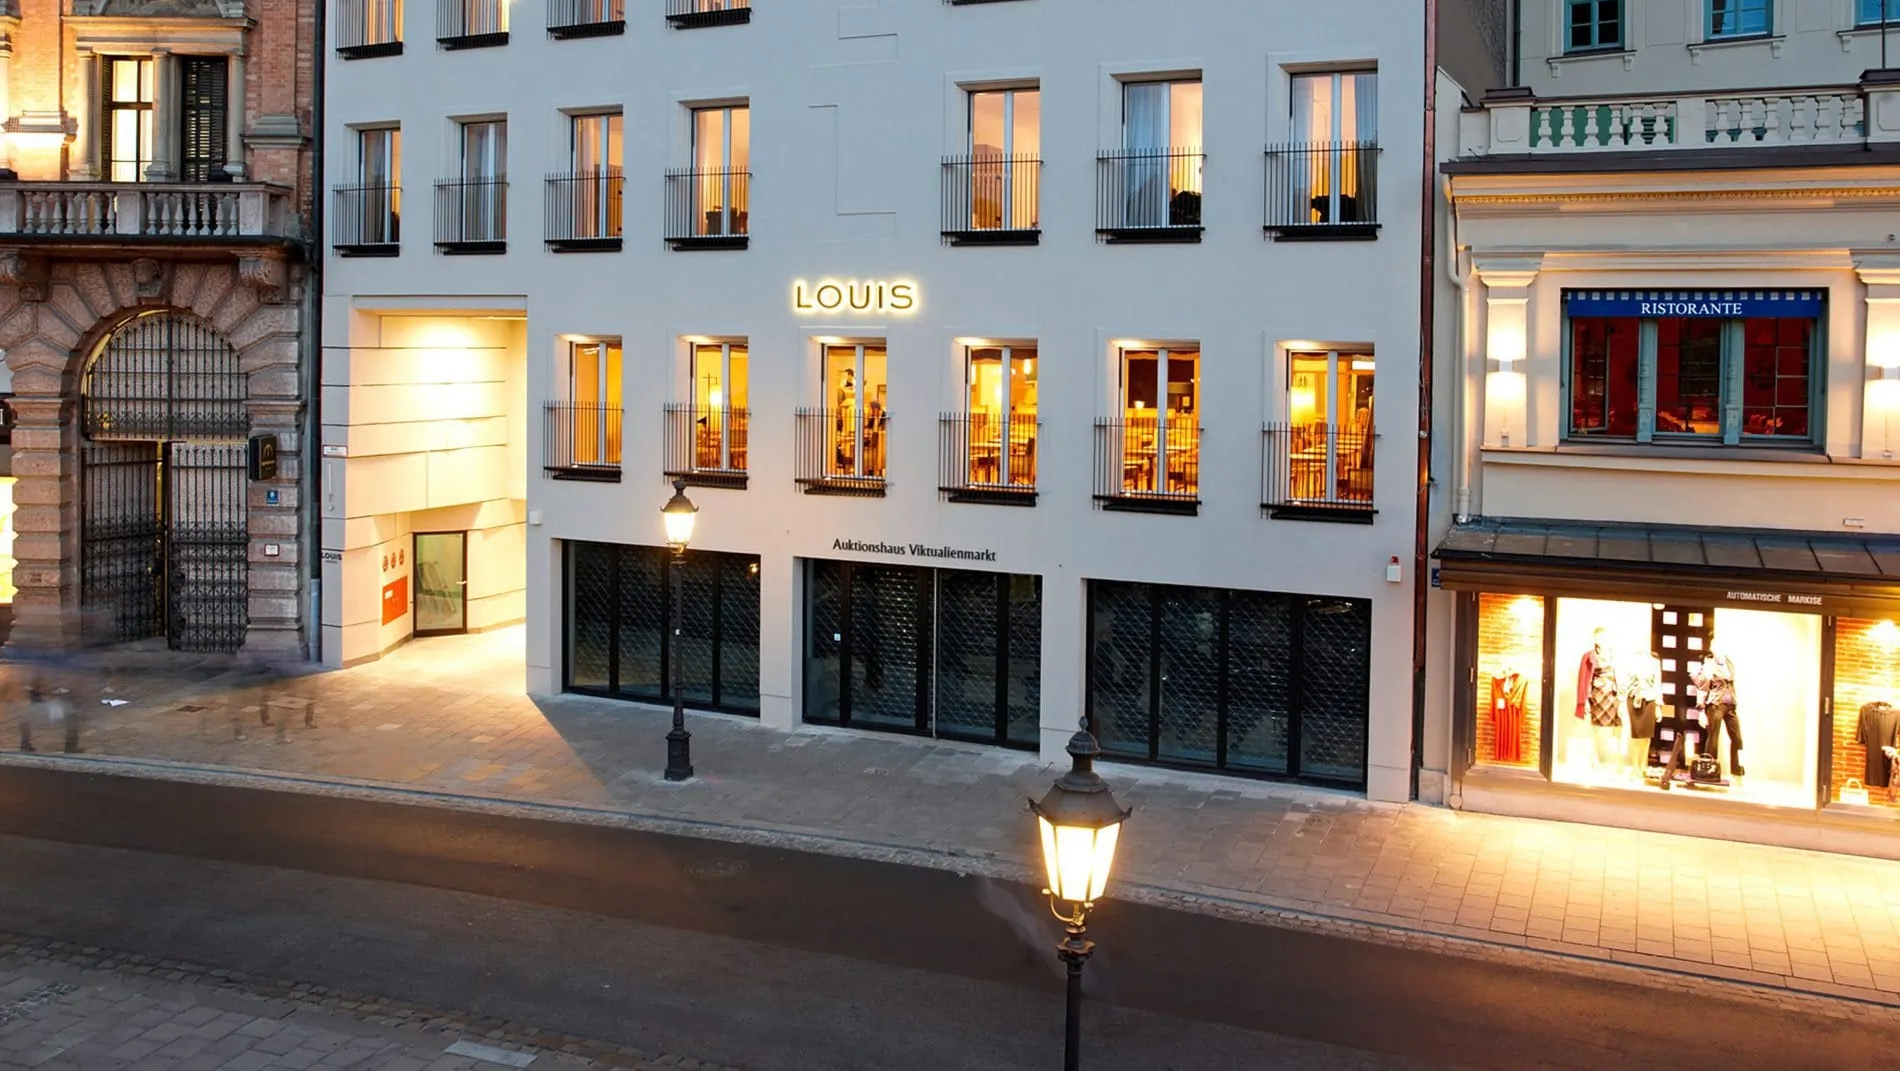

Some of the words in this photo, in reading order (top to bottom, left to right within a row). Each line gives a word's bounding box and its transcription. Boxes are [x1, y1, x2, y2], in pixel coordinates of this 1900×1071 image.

[797, 285, 913, 309] LOUIS
[1641, 302, 1743, 315] RISTORANTE
[320, 551, 342, 560] LOUIS
[832, 538, 906, 555] Auktionshaus
[908, 543, 997, 562] Viktualienmarkt
[1726, 591, 1782, 603] AUTOMATISCHE
[1787, 595, 1823, 606] MARKISE
